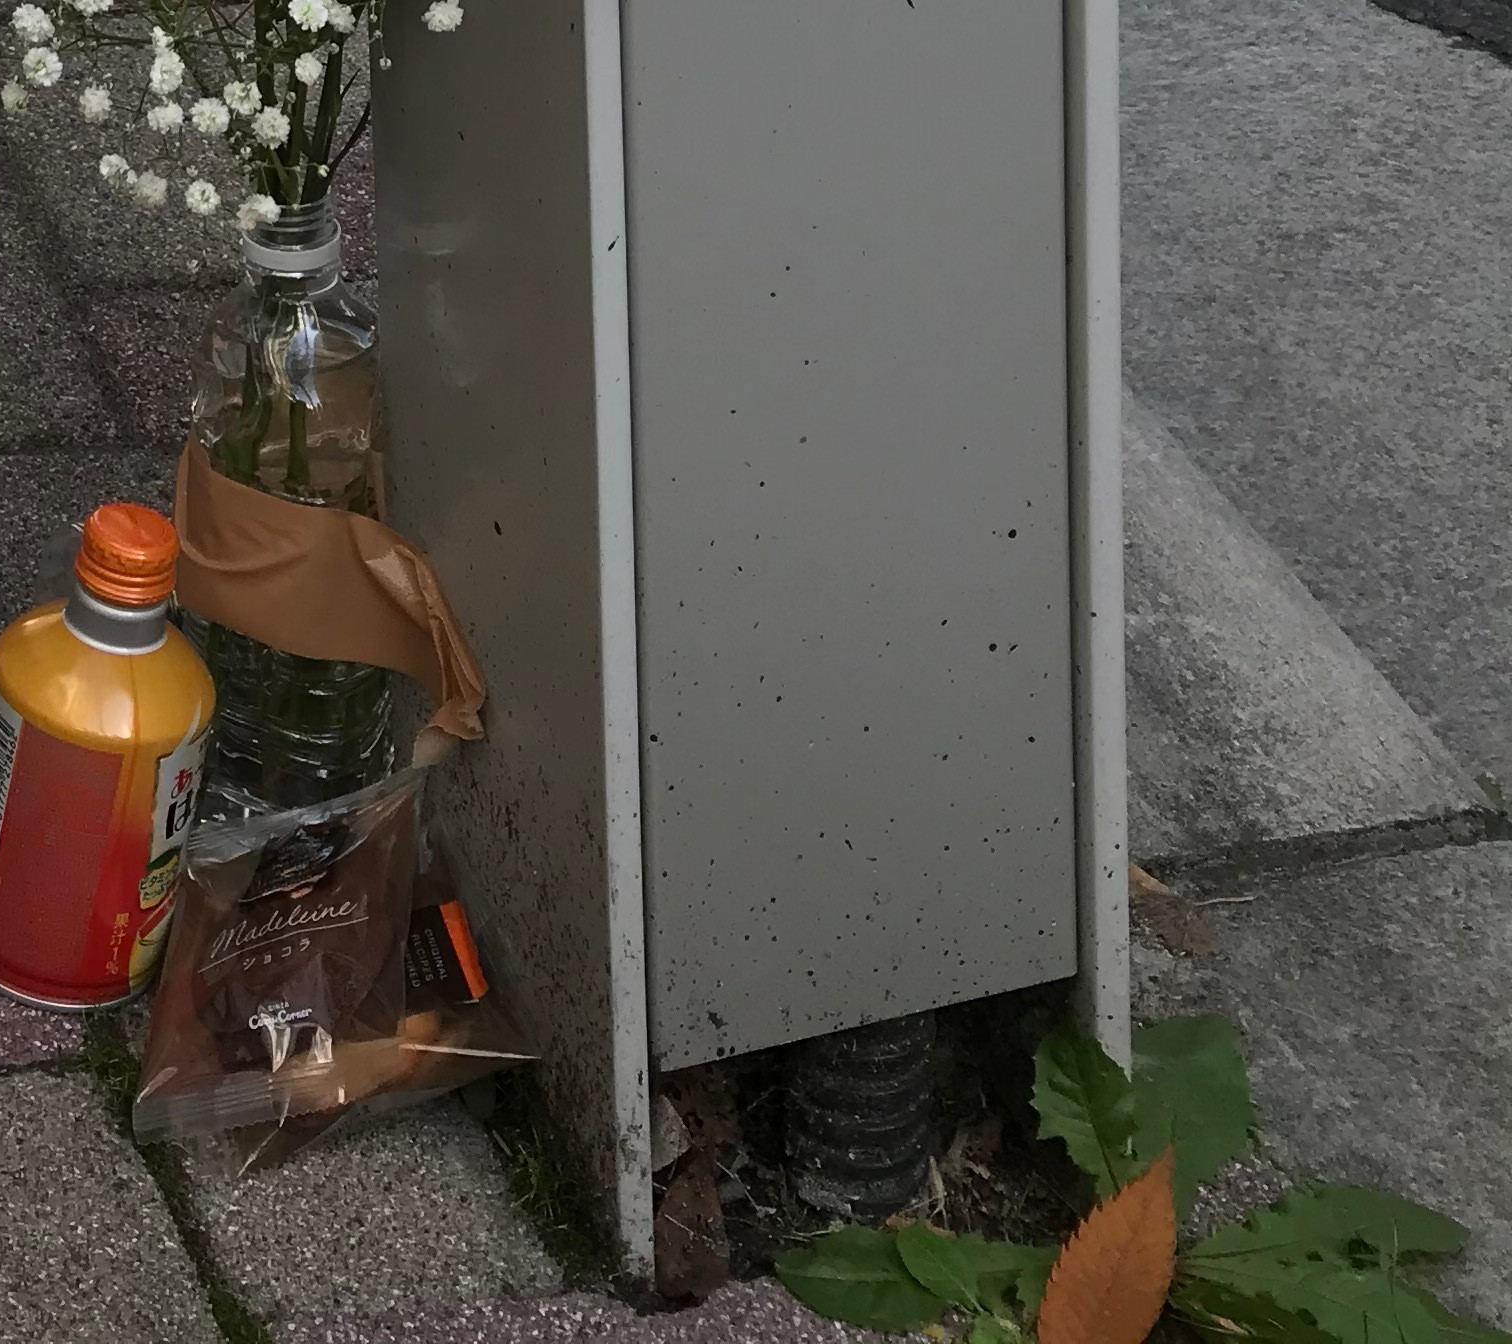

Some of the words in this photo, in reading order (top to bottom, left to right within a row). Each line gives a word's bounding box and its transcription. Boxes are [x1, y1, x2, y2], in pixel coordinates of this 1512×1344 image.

[210, 899, 360, 959] Madeleine
[241, 937, 312, 972] ショコラ
[423, 928, 448, 981] ORIGINAL
